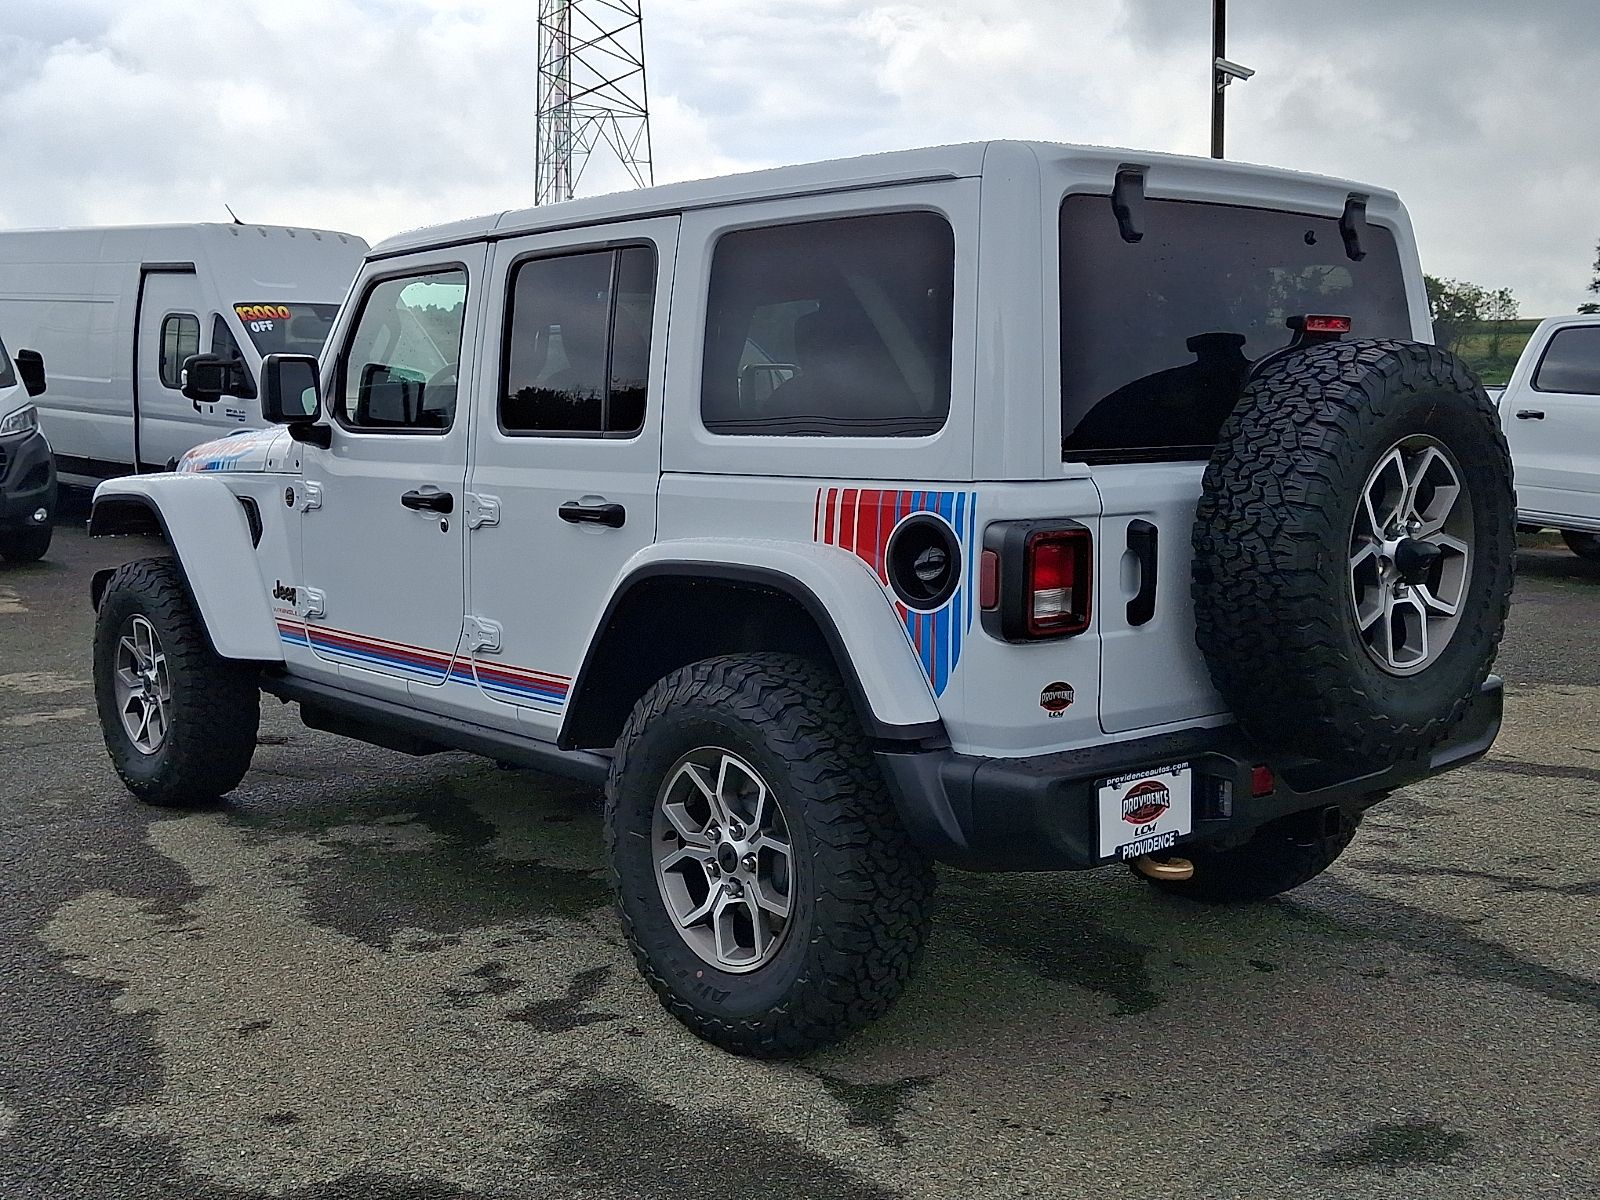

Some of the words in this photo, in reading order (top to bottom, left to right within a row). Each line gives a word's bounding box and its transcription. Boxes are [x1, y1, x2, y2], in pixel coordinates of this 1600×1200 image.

[250, 320, 274, 333] OFF
[272, 579, 297, 607] Jeep
[1041, 690, 1074, 705] PROVIDENCE
[1106, 761, 1189, 787] providenceautos.com
[1122, 789, 1169, 819] PROVIDENCE
[1122, 831, 1175, 860] PROVIDENCE
